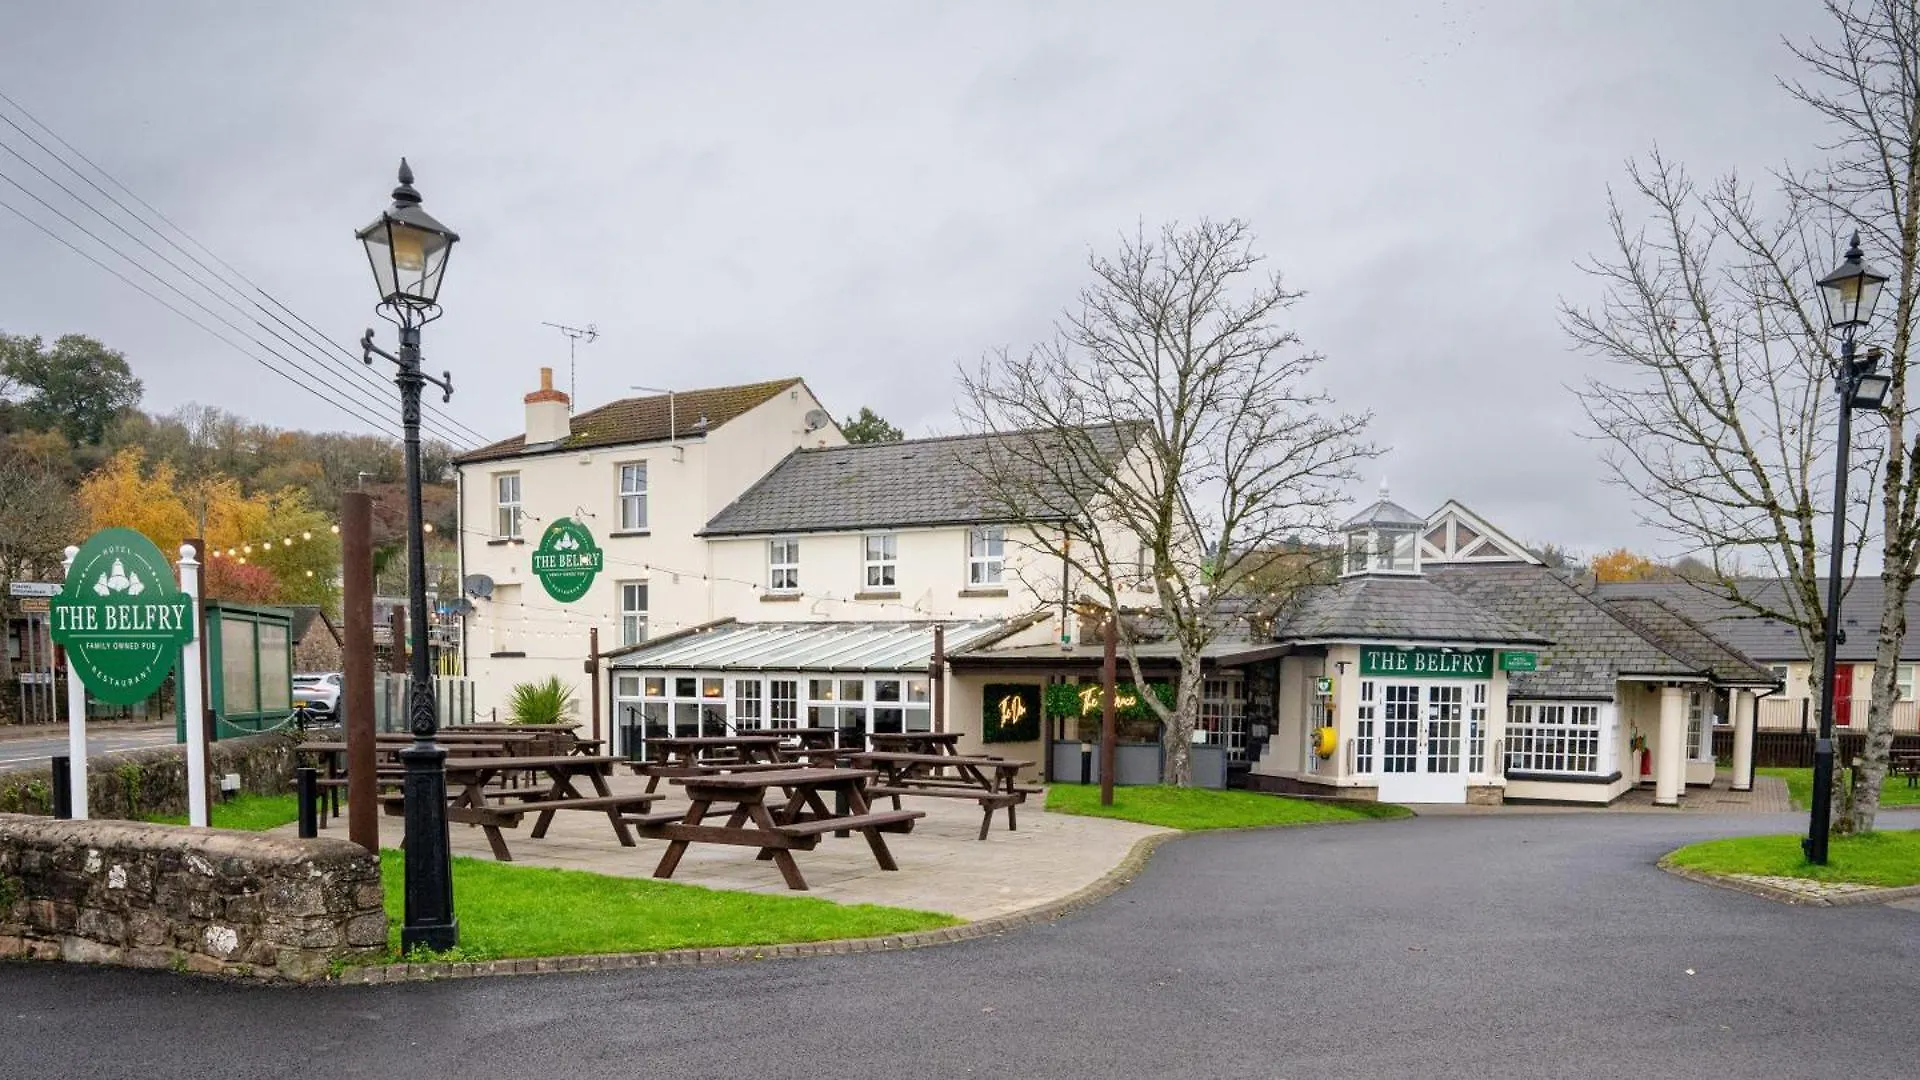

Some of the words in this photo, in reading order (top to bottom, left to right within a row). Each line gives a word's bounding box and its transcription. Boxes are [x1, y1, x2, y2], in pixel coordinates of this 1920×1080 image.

[534, 555, 557, 569] THE
[56, 605, 98, 630] THE
[104, 604, 186, 630] BELFRY
[86, 641, 111, 651] FAMILY
[112, 641, 139, 651] OWNED
[141, 641, 156, 651] PUB
[1368, 651, 1408, 671] THE
[1414, 652, 1486, 673] BELFRY
[91, 664, 153, 688] RESTAURANT
